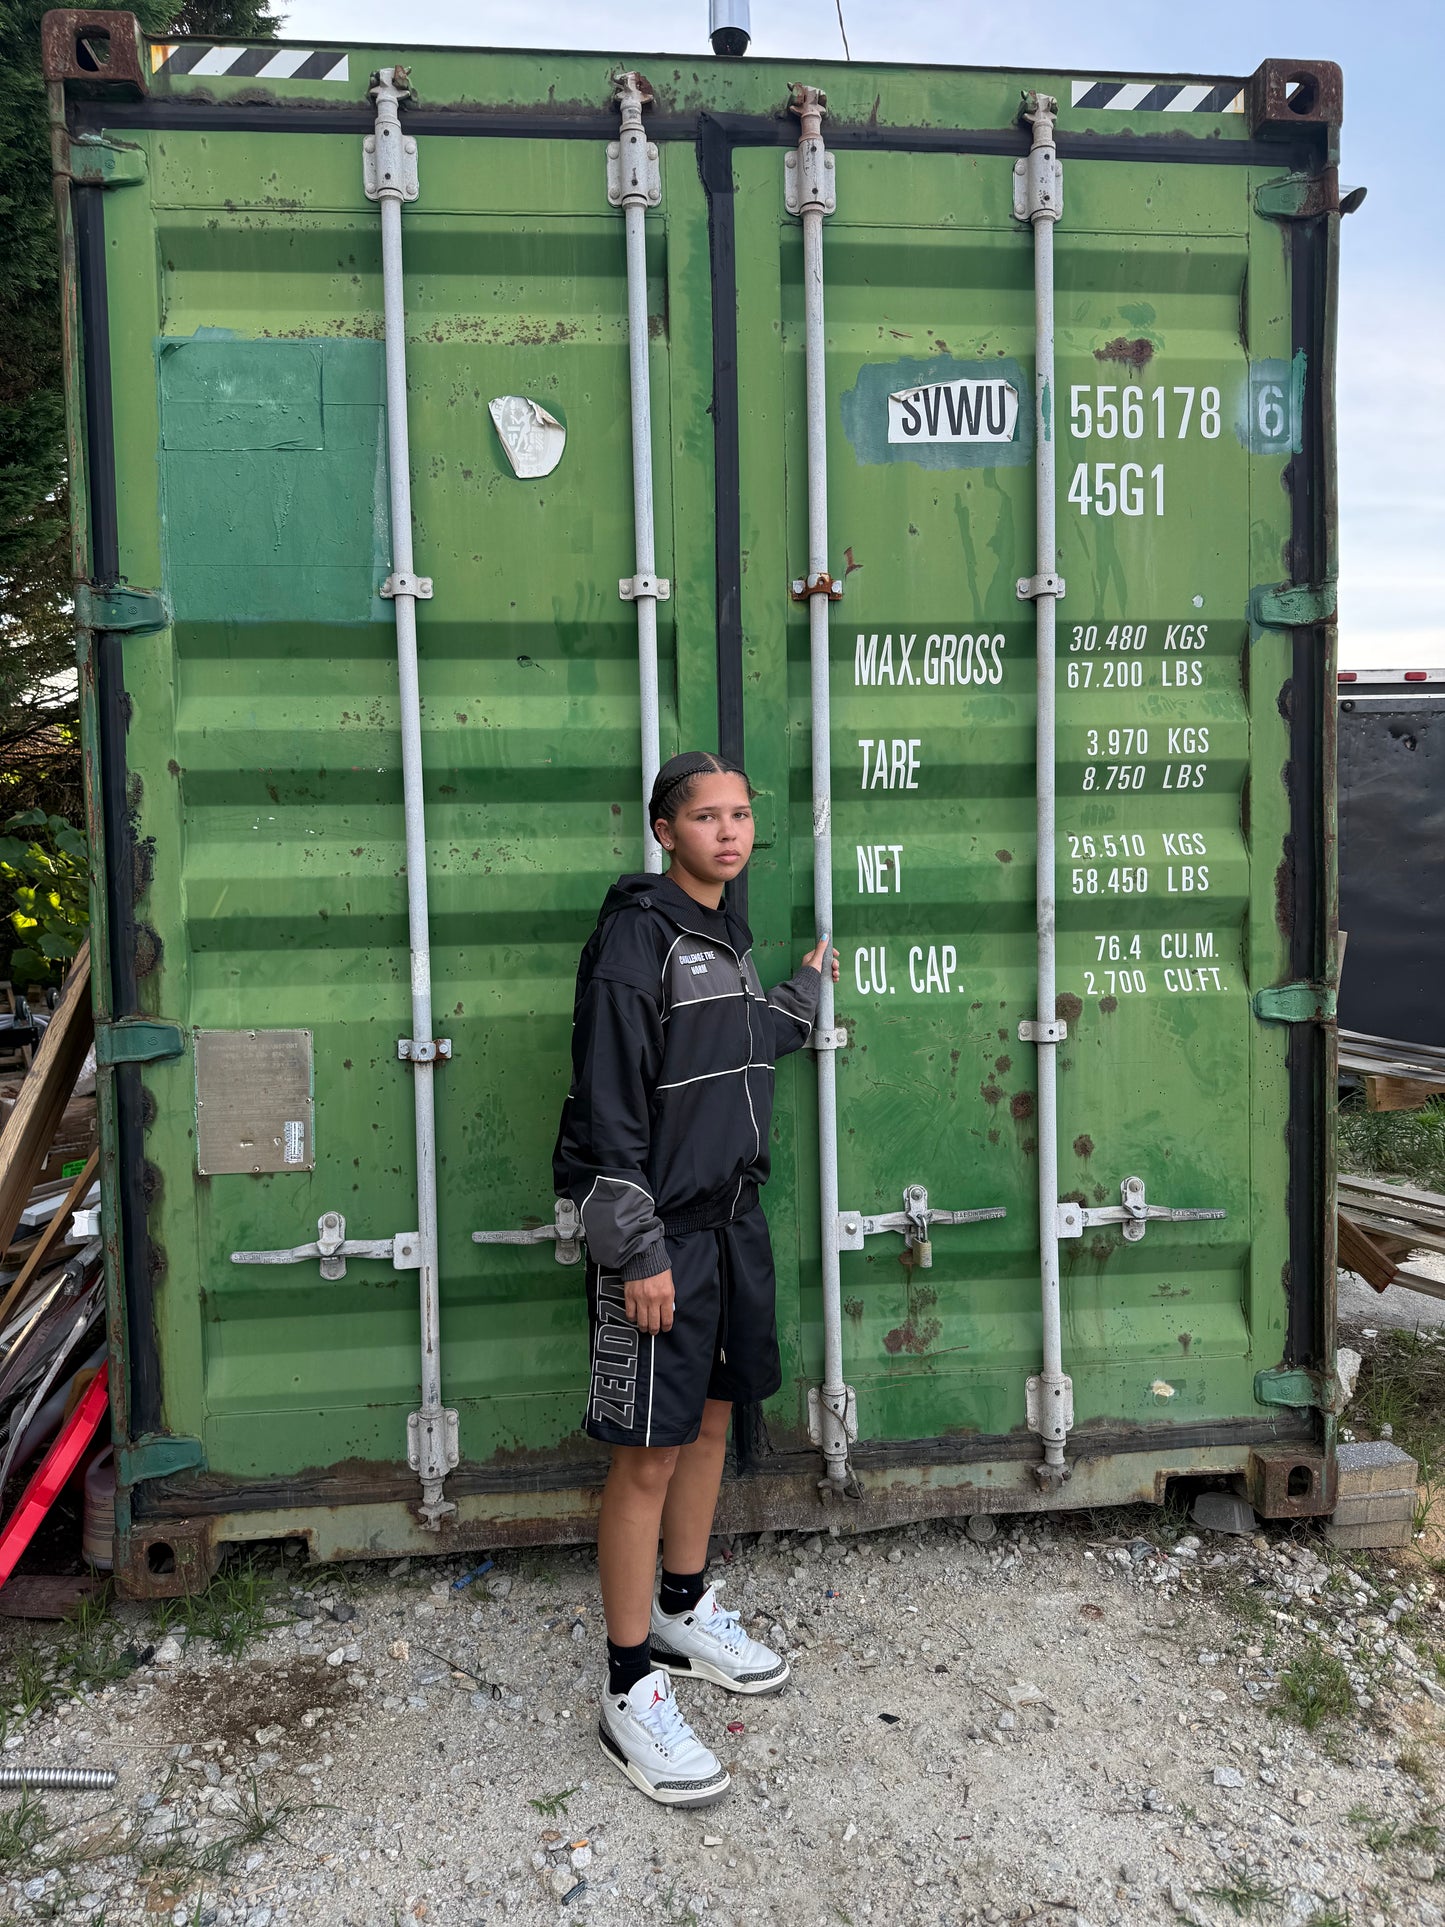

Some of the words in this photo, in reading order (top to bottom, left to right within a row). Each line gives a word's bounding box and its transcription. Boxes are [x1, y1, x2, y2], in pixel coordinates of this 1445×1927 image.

[901, 385, 1006, 437] SVWU
[1070, 384, 1221, 439] 556178
[1257, 384, 1284, 438] 6
[1067, 462, 1165, 517] 45G1
[854, 633, 1006, 686] MAX.GROSS
[1163, 624, 1208, 650] KGS
[1161, 660, 1203, 687] LBS
[858, 738, 922, 790] TARE
[1168, 727, 1210, 754] KGS
[1162, 764, 1207, 789] LBS
[855, 844, 904, 894] NET
[1161, 832, 1207, 857] KGS
[1167, 865, 1209, 892] LBS
[679, 952, 705, 965] CHALLENGE
[704, 950, 716, 961] THE
[854, 946, 896, 995] CU.
[909, 945, 965, 994] CAP.
[1094, 934, 1142, 962] 76.4
[1160, 932, 1219, 959] CU.M.
